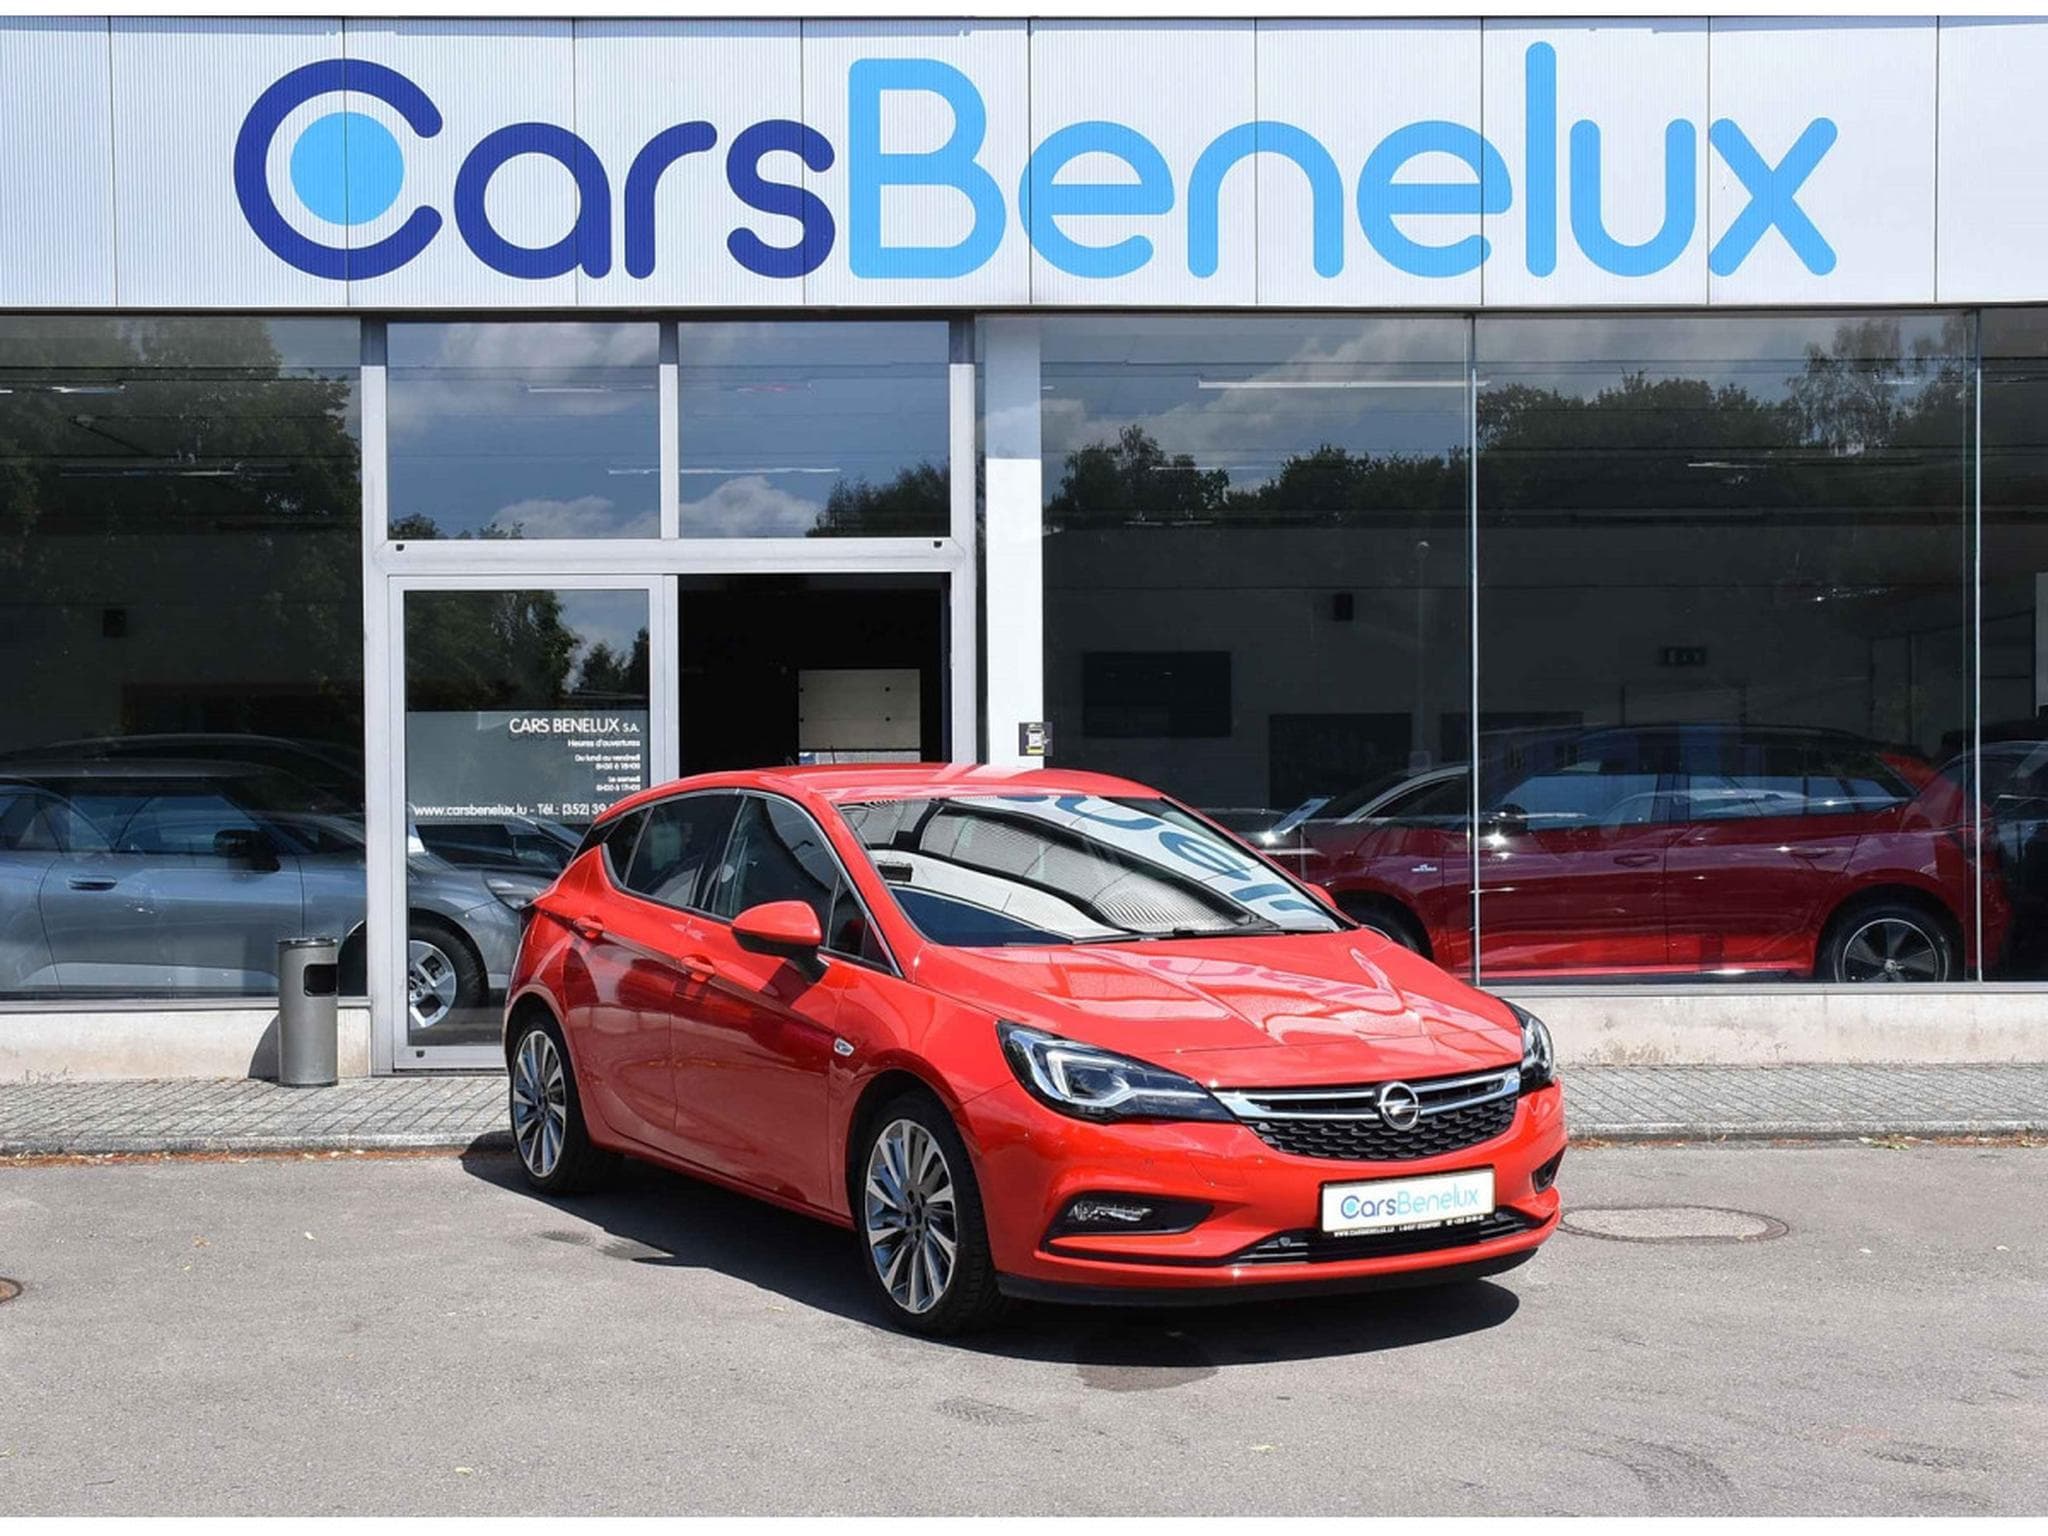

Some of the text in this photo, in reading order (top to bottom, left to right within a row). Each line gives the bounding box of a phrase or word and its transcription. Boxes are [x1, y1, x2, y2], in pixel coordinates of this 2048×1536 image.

[234, 42, 1837, 280] CarsBenelux
[509, 718, 640, 733] CARS BENELUX S.A.
[415, 803, 527, 817] www.carsbenelux.lu
[1340, 1183, 1479, 1220] CarsBenelux
